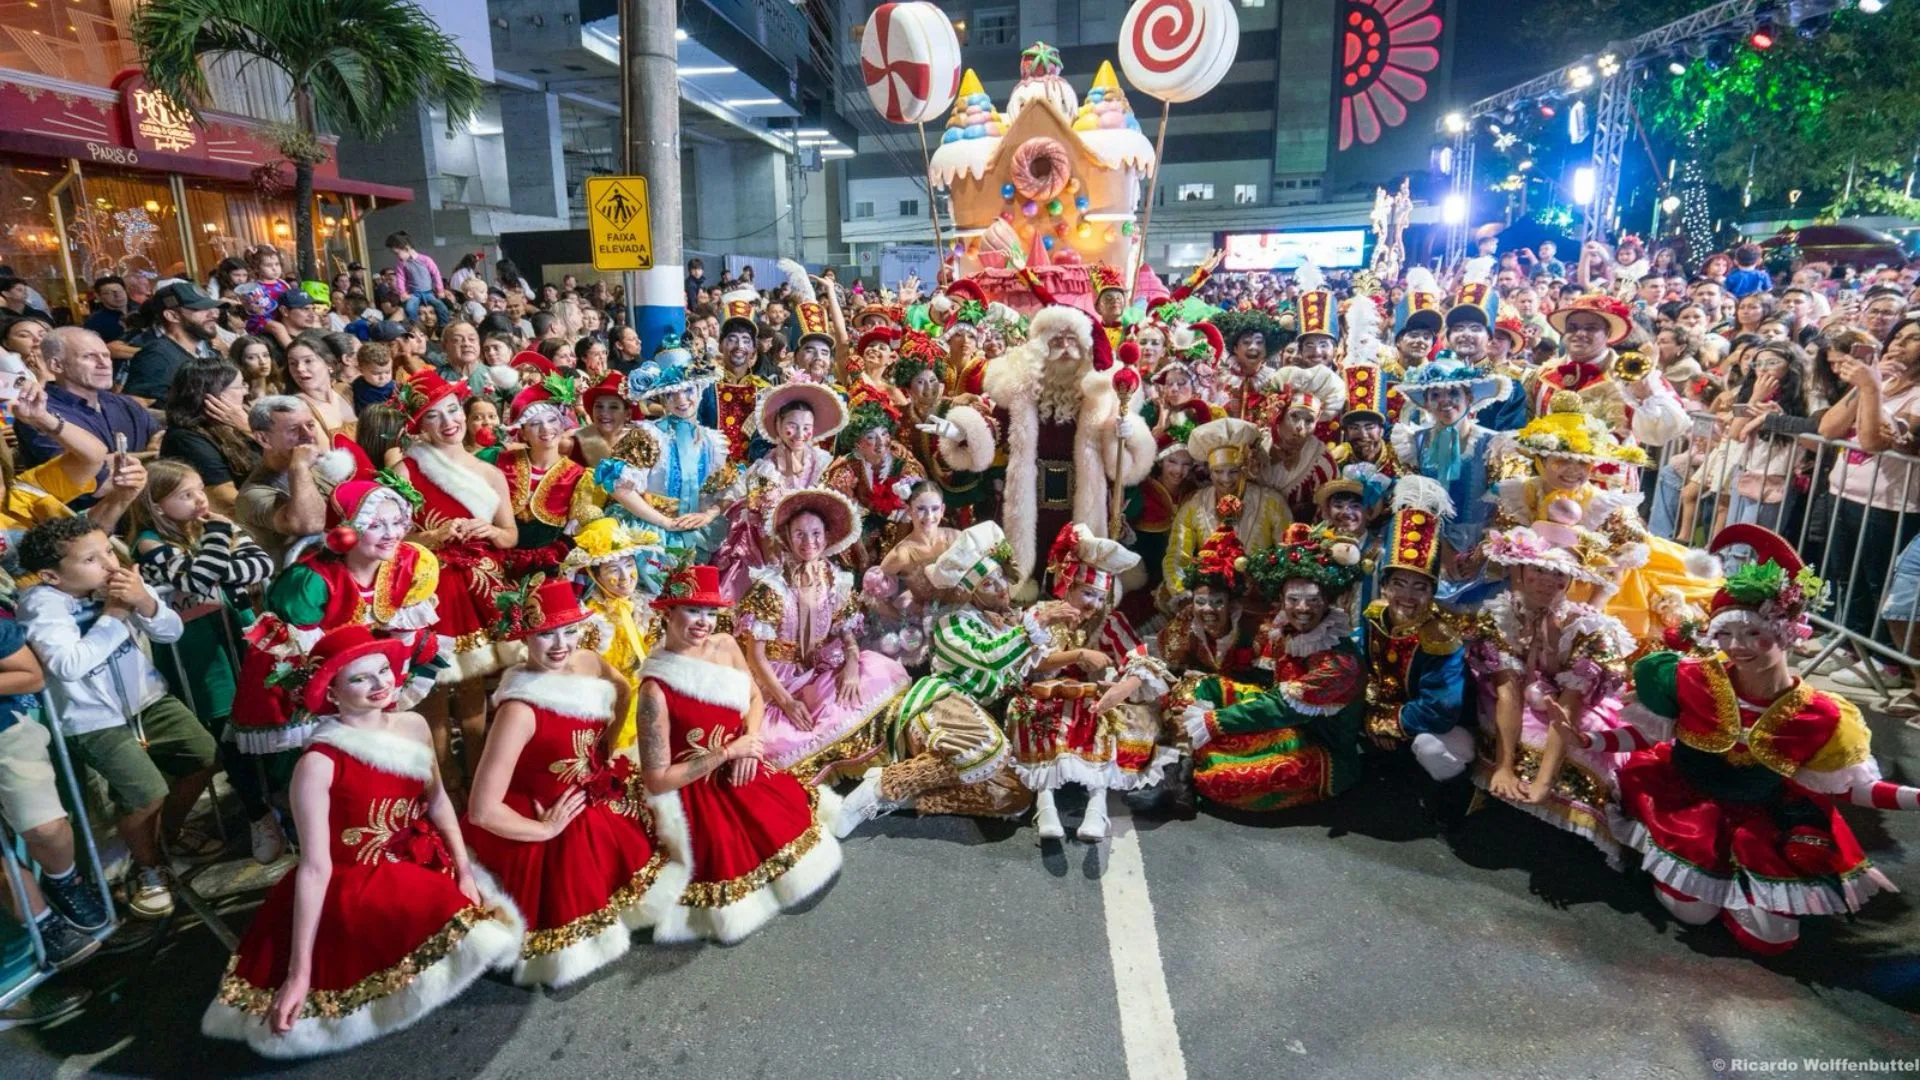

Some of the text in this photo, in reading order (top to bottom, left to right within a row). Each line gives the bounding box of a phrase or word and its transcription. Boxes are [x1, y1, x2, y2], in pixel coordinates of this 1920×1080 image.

[87, 142, 138, 164] PARIS 6
[606, 233, 637, 241] FAIXA
[599, 244, 647, 253] ELEVADA
